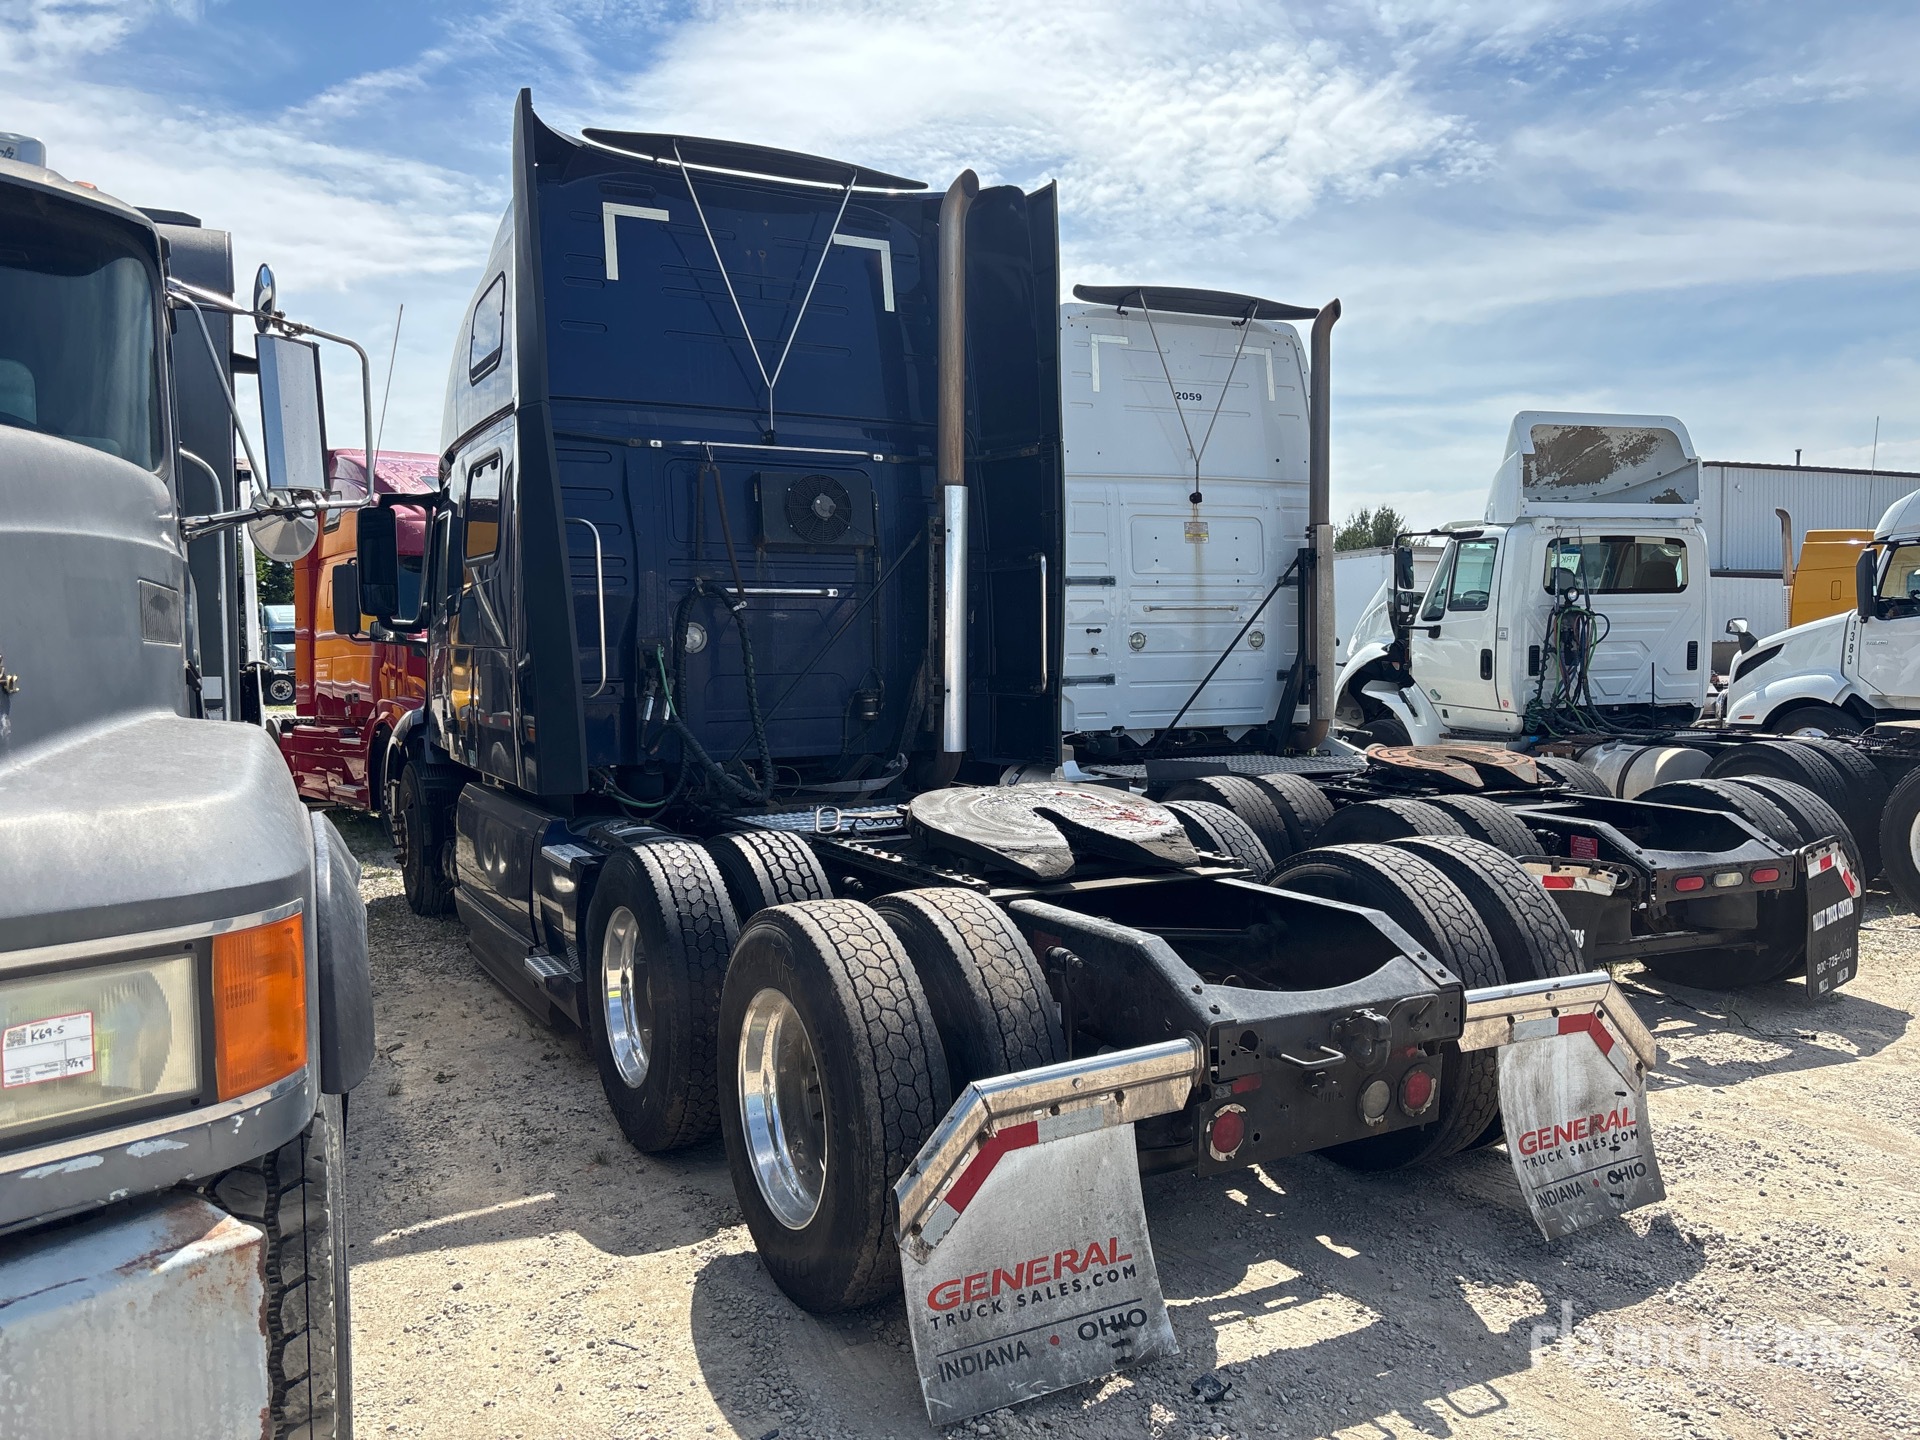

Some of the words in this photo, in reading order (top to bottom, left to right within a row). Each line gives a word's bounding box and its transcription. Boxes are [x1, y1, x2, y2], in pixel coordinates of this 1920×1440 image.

[1175, 392, 1202, 401] 2059
[1847, 621, 1857, 665] 1383
[31, 1025, 64, 1042] K69-5
[1518, 1107, 1637, 1155] GENERAL
[1523, 1150, 1564, 1170] TRUCK
[1569, 1128, 1639, 1157] SALES.COM
[1535, 1181, 1586, 1210] INDIANA
[1607, 1162, 1647, 1185] OHIO
[927, 1237, 1133, 1312] GENERAL
[930, 1300, 1004, 1331] TRUCK
[1016, 1263, 1137, 1308] SALES.COM
[938, 1340, 1032, 1383] INDIANA
[1077, 1308, 1148, 1341] OHIO
